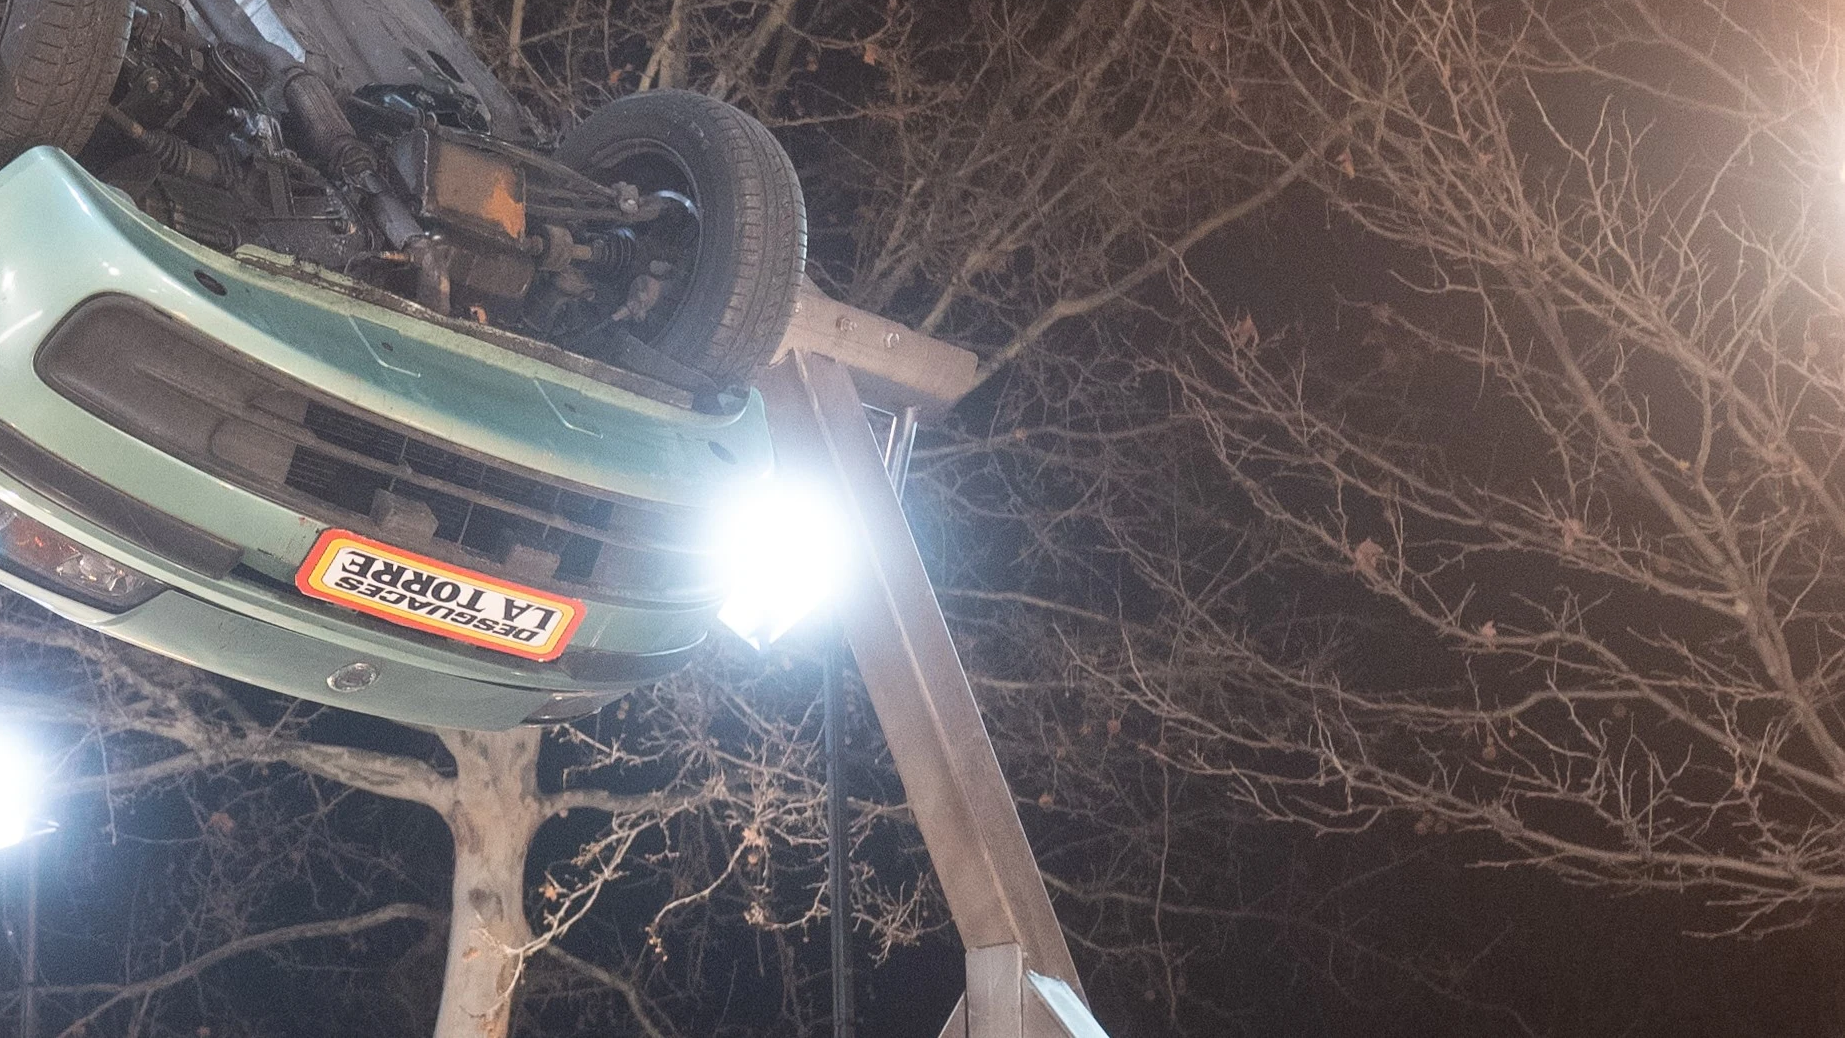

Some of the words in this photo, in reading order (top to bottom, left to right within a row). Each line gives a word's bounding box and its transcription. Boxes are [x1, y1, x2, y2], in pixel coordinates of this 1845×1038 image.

[335, 575, 540, 643] DESGUACES
[341, 550, 488, 612] TORRE
[503, 597, 558, 632] LA
